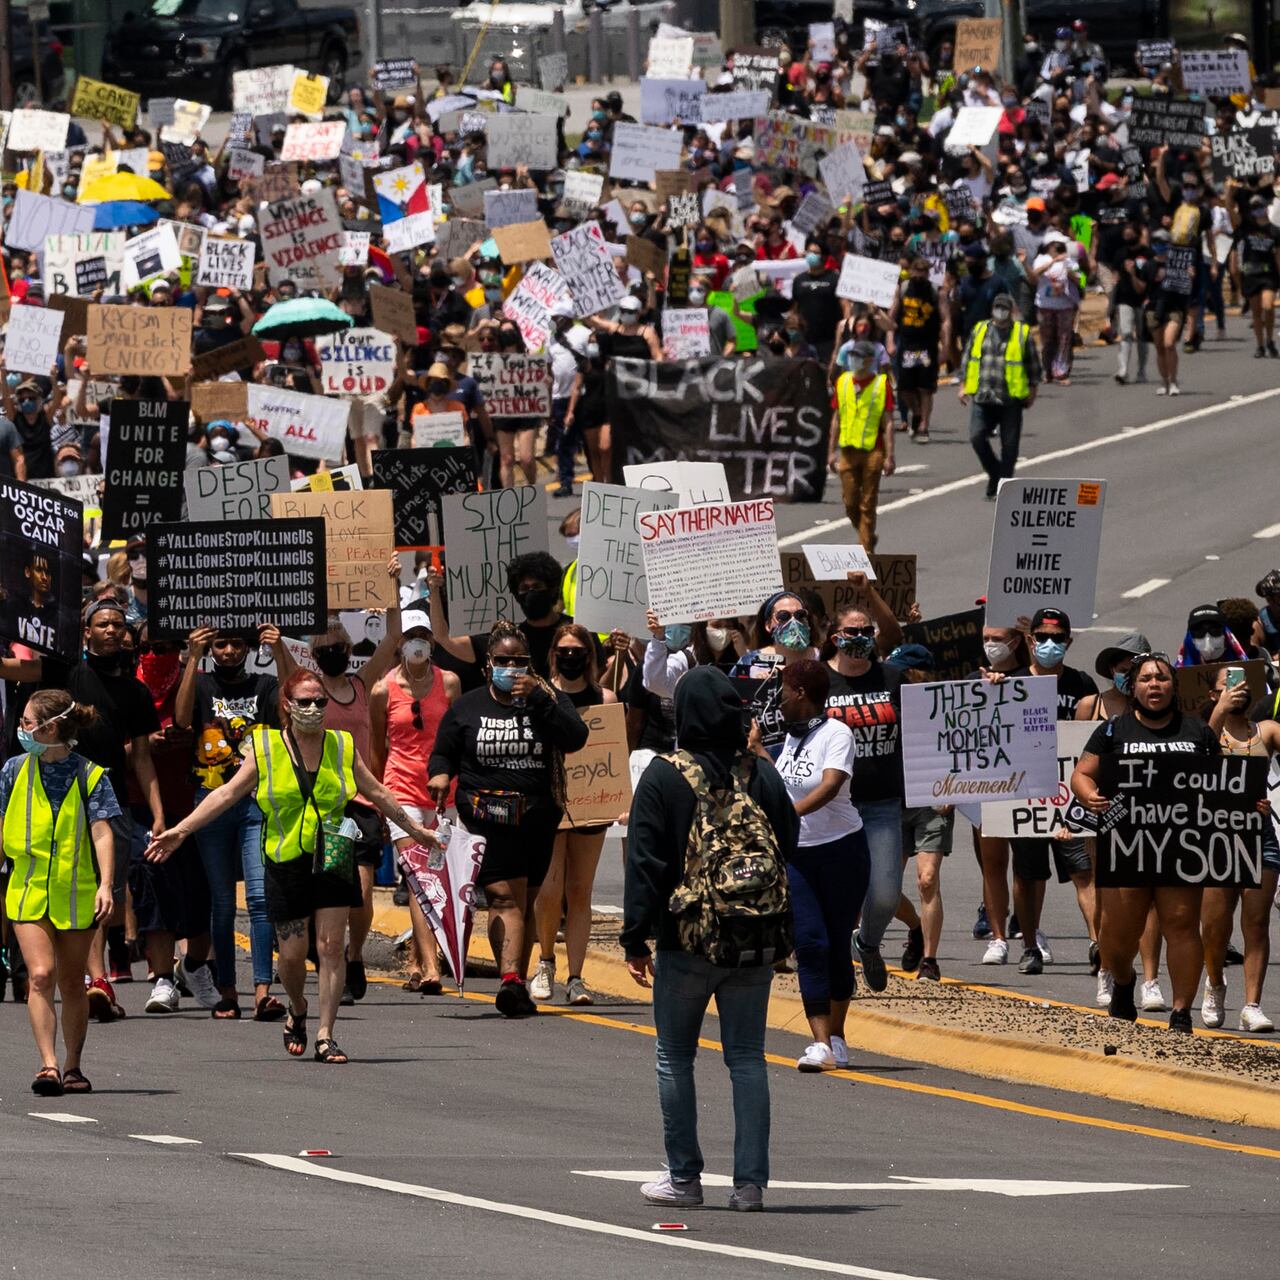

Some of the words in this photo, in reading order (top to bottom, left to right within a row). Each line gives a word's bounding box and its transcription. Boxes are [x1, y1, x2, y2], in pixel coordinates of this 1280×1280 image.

[1213, 135, 1249, 156] BLACK
[1234, 160, 1275, 176] MATTER
[263, 208, 328, 239] SILENCE
[206, 243, 247, 255] BLACK
[272, 234, 342, 267] VIOLENCE
[209, 256, 243, 270] LIVES
[200, 272, 248, 289] MATTER
[335, 333, 374, 345] Your
[321, 346, 392, 361] SILENCE
[349, 365, 364, 376] is
[328, 376, 386, 393] LOUD
[139, 402, 167, 418] BLM
[120, 425, 178, 442] UNITE
[709, 407, 822, 447] LIVES
[135, 448, 164, 464] FOR
[110, 471, 178, 487] CHANGE
[198, 459, 279, 498] DESIS
[0, 485, 61, 517] JUSTICE
[64, 507, 78, 519] FOR
[1023, 487, 1068, 506] WHITE
[14, 504, 65, 533] OSCAR
[463, 486, 536, 530] STOP
[641, 513, 679, 540] SAY
[679, 505, 726, 532] THEIR
[725, 501, 774, 526] NAMES
[1011, 510, 1076, 528] SILENCE
[21, 522, 59, 546] CAIN
[472, 524, 529, 561] THE
[1016, 553, 1061, 571] WHITE
[1003, 577, 1071, 595] CONSENT
[926, 684, 987, 719] THIS
[999, 680, 1027, 705] IS
[945, 709, 984, 729] NOT
[992, 707, 1001, 724] A
[938, 724, 1014, 751] MOMENT
[477, 741, 529, 757] Antron
[950, 749, 986, 772] ITS
[989, 748, 1010, 767] A
[933, 771, 1026, 798] Movement!
[1119, 760, 1158, 789] It
[1174, 760, 1245, 793] could
[1132, 799, 1188, 825] have
[1197, 796, 1261, 829] been
[1110, 829, 1174, 874] MY
[1177, 829, 1261, 884] SON
